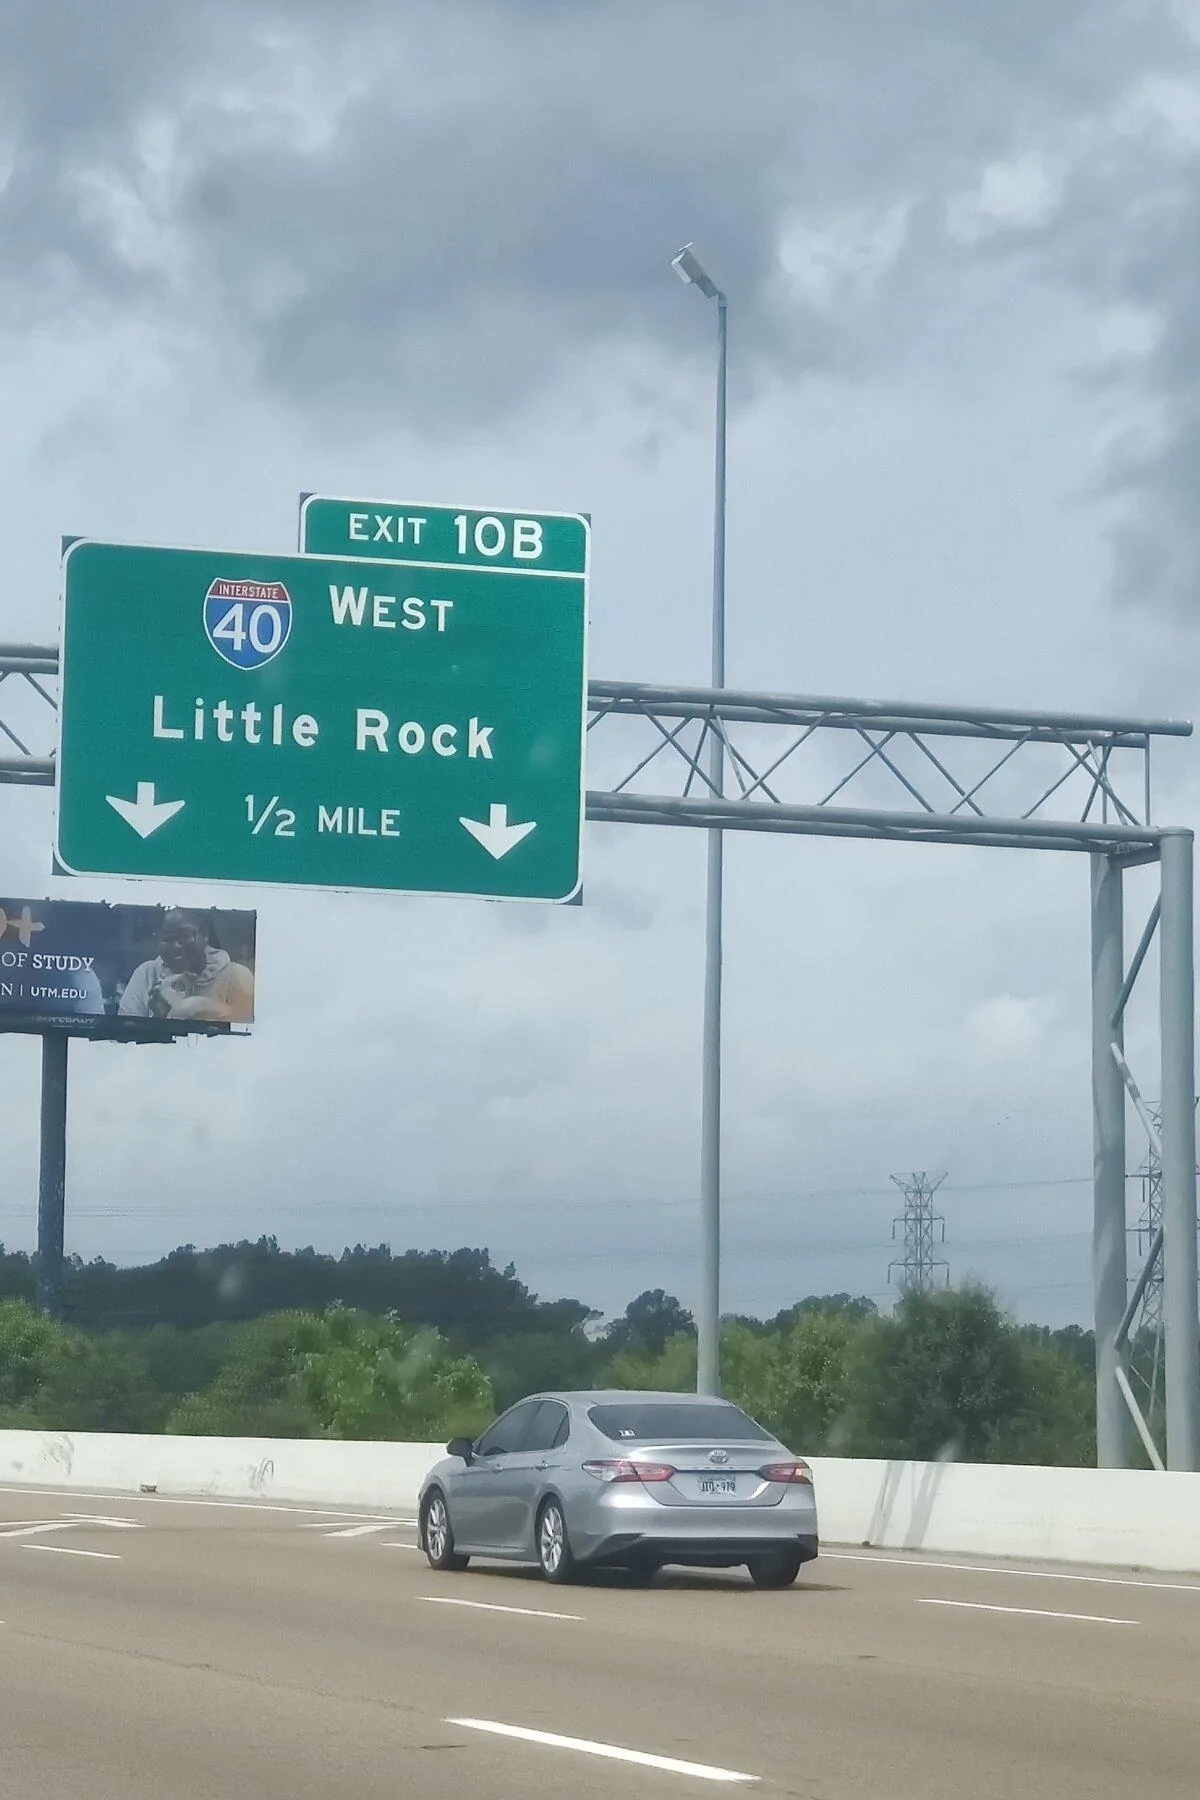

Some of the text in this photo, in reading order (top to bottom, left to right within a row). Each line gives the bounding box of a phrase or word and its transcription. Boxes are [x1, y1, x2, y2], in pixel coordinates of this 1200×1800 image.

[349, 513, 544, 559] EXIT 10B
[219, 585, 278, 599] INTERSTATE
[329, 585, 454, 632] WEST
[212, 603, 282, 653] 40
[153, 695, 495, 759] Little Rock
[318, 805, 401, 836] MILE
[1, 951, 28, 968] OF
[32, 953, 94, 972] STUDY
[30, 986, 87, 999] UTM.EDU
